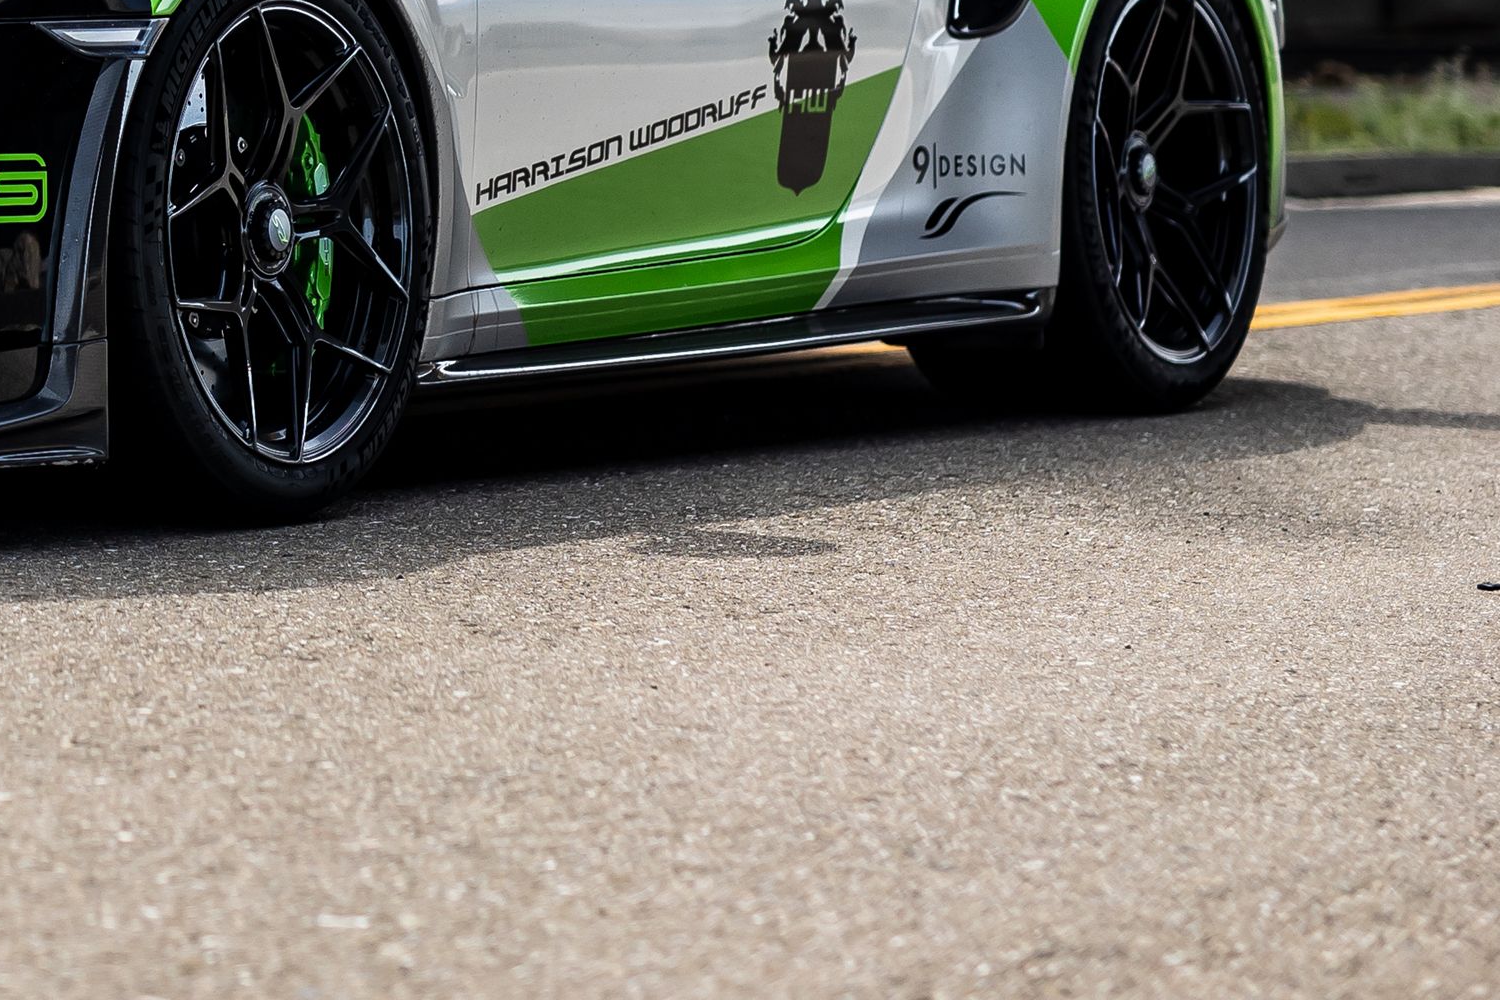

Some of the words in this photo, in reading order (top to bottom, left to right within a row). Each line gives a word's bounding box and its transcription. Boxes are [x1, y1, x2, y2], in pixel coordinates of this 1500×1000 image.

[788, 87, 829, 114] HW
[475, 134, 623, 206] HARRISON
[629, 84, 767, 152] WOODRUFF
